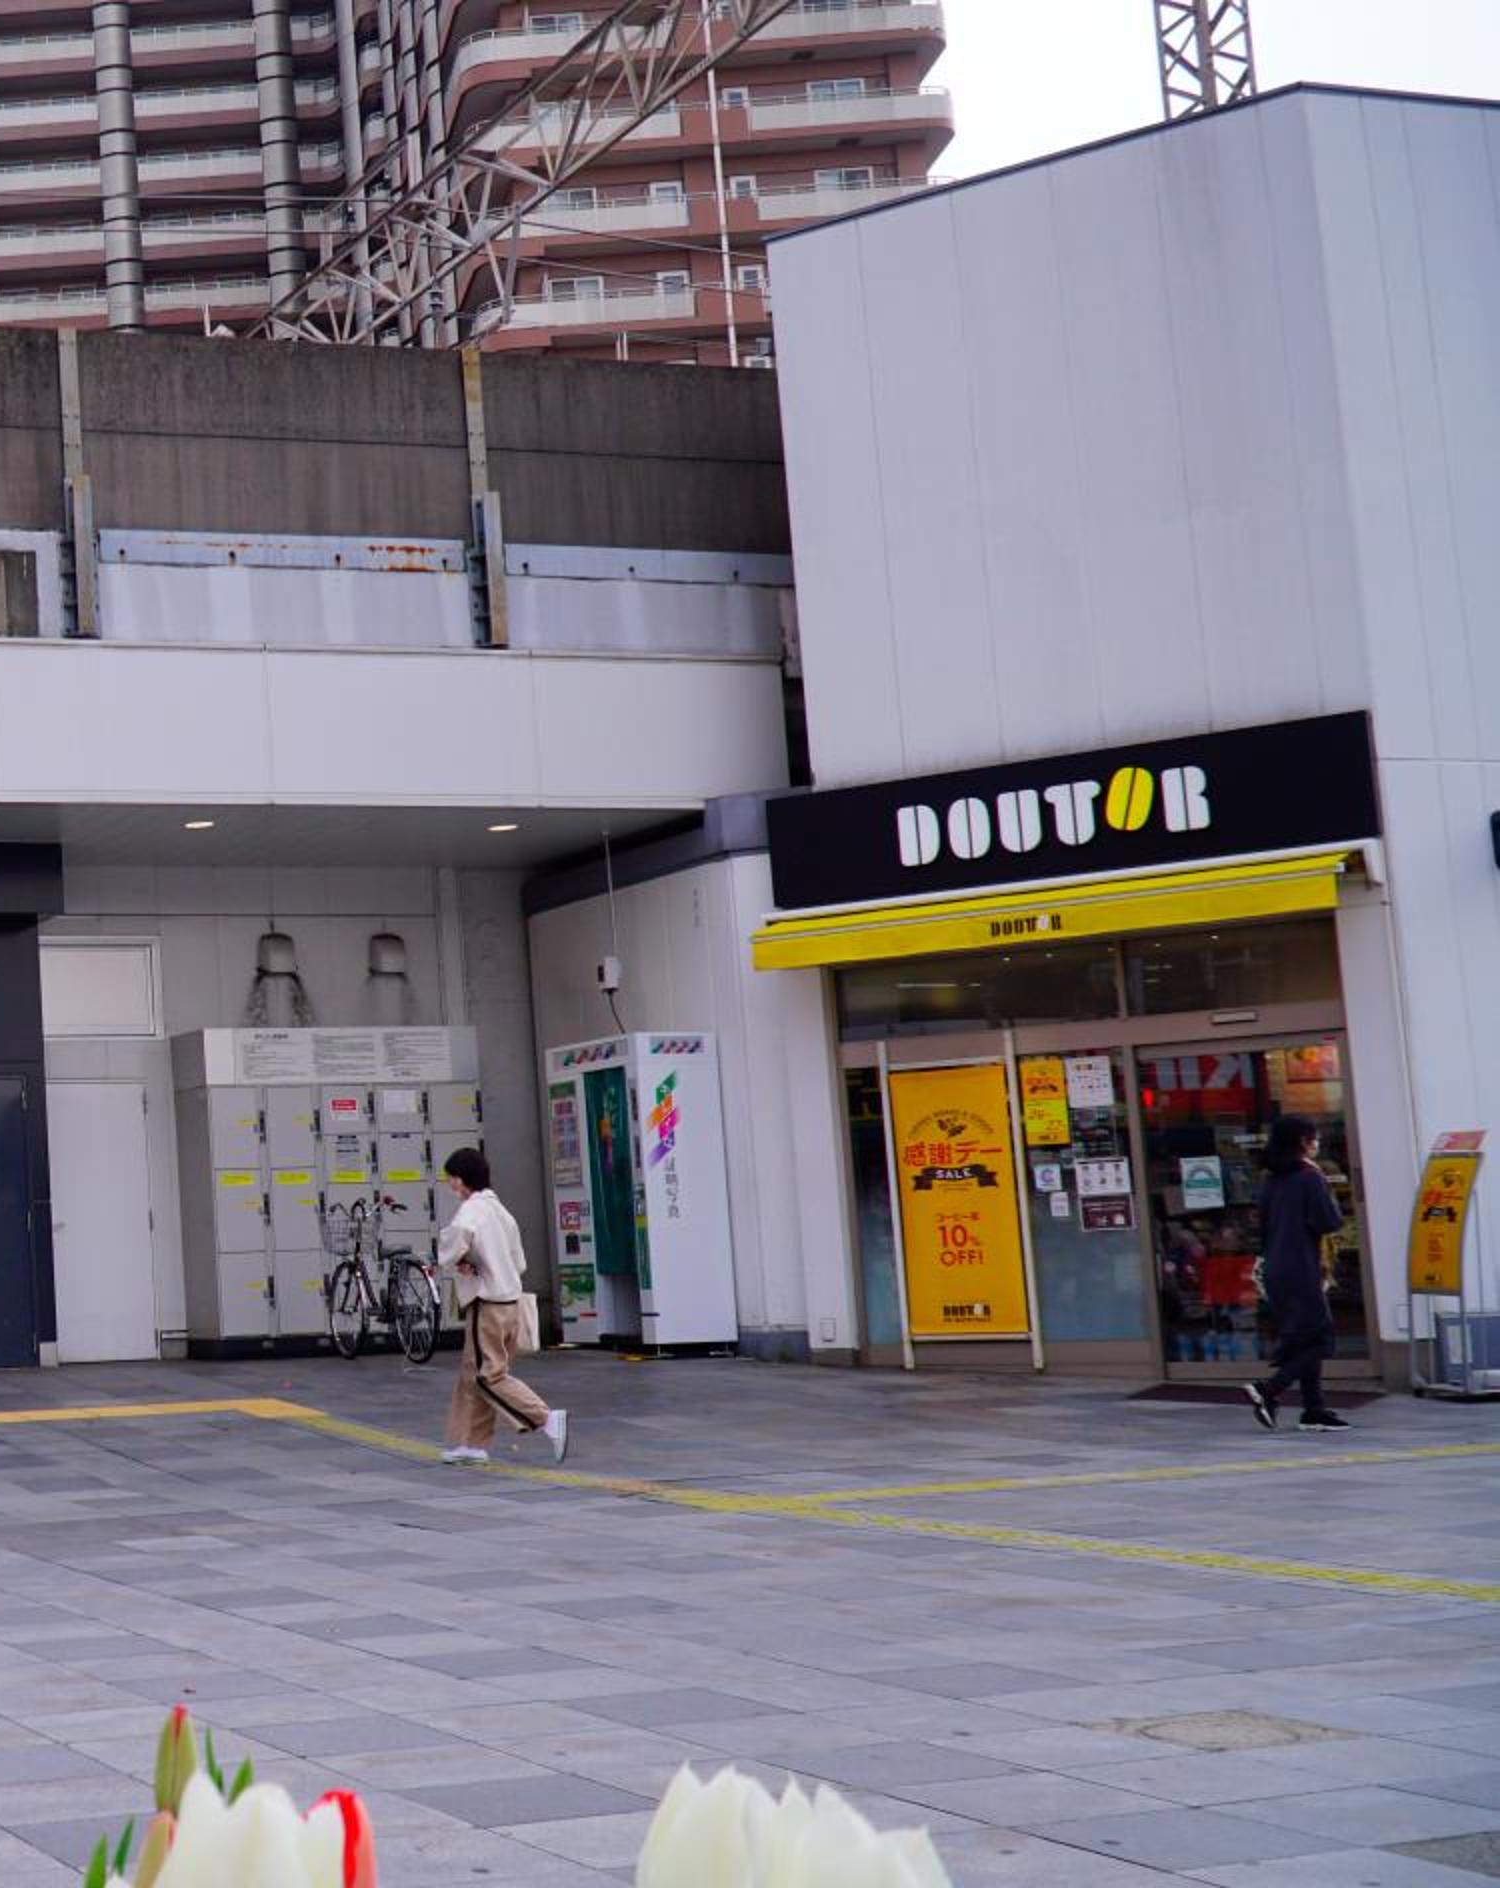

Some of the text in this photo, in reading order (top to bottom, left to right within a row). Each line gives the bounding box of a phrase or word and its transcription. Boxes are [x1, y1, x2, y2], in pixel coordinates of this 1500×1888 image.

[896, 766, 1211, 867] DOUTOR
[991, 914, 1062, 937] DOUTOR
[903, 1141, 1003, 1167] 感謝デー
[936, 1167, 972, 1179] SALE
